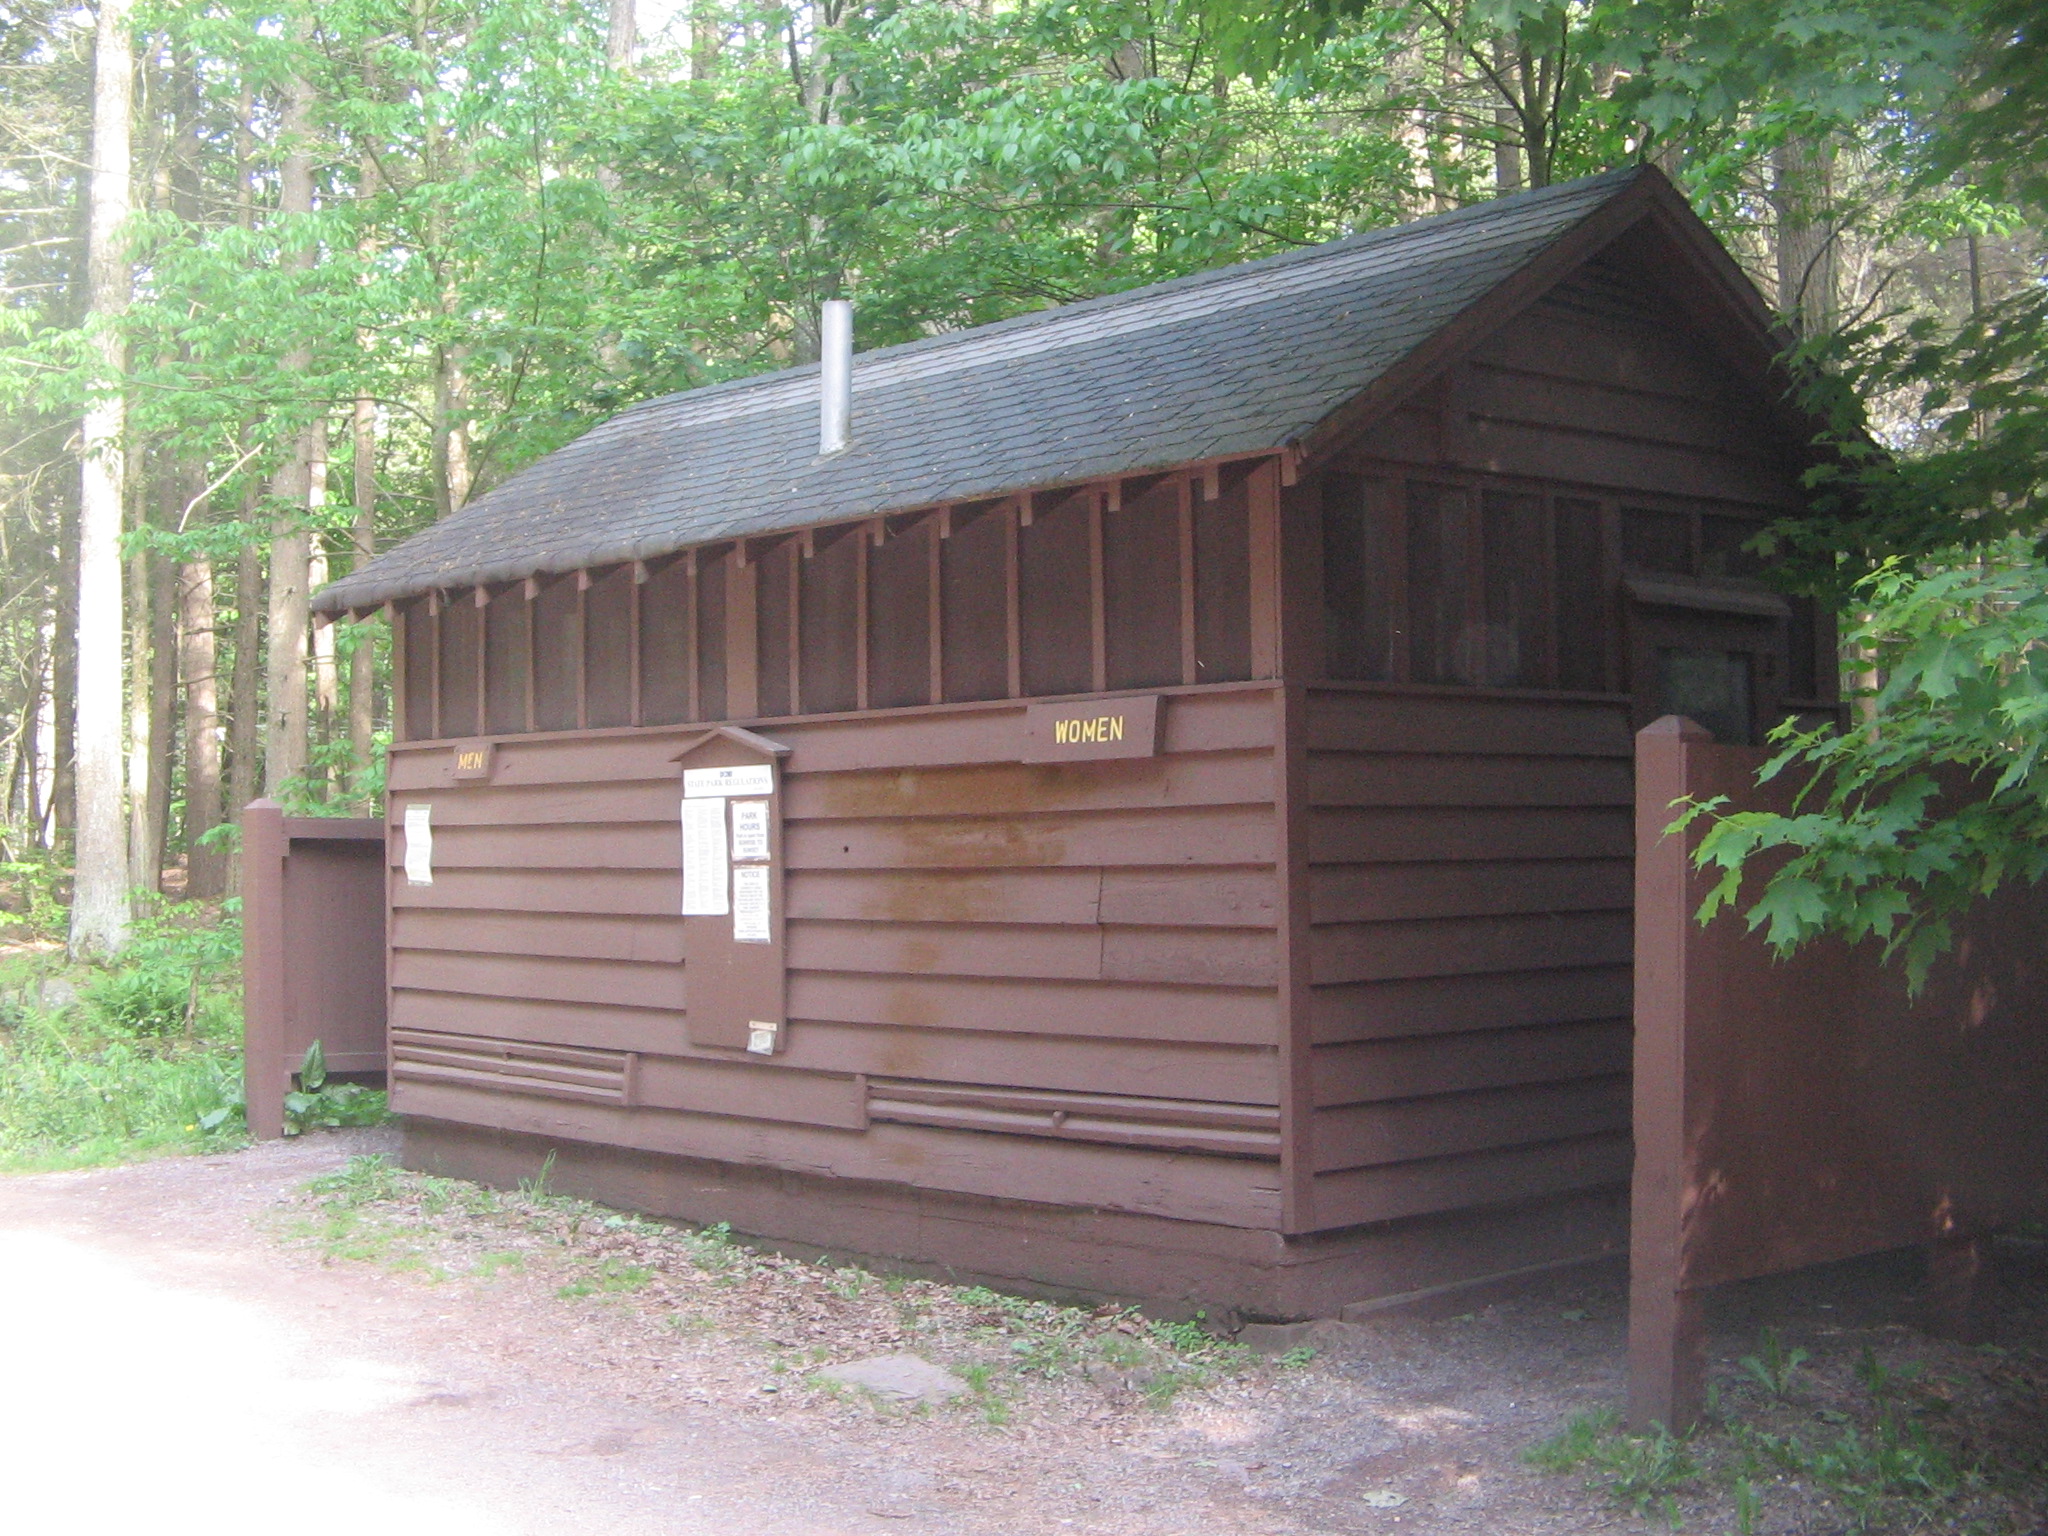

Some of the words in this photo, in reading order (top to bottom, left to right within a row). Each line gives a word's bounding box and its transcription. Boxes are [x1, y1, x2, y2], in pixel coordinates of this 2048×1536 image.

[1055, 715, 1124, 744] WOMEN
[457, 751, 483, 770] MEN
[687, 779, 704, 788] STATE
[706, 779, 723, 787] PARK
[725, 776, 768, 786] REGULATIONS
[741, 812, 757, 820] PARK
[739, 823, 760, 831] HOURS
